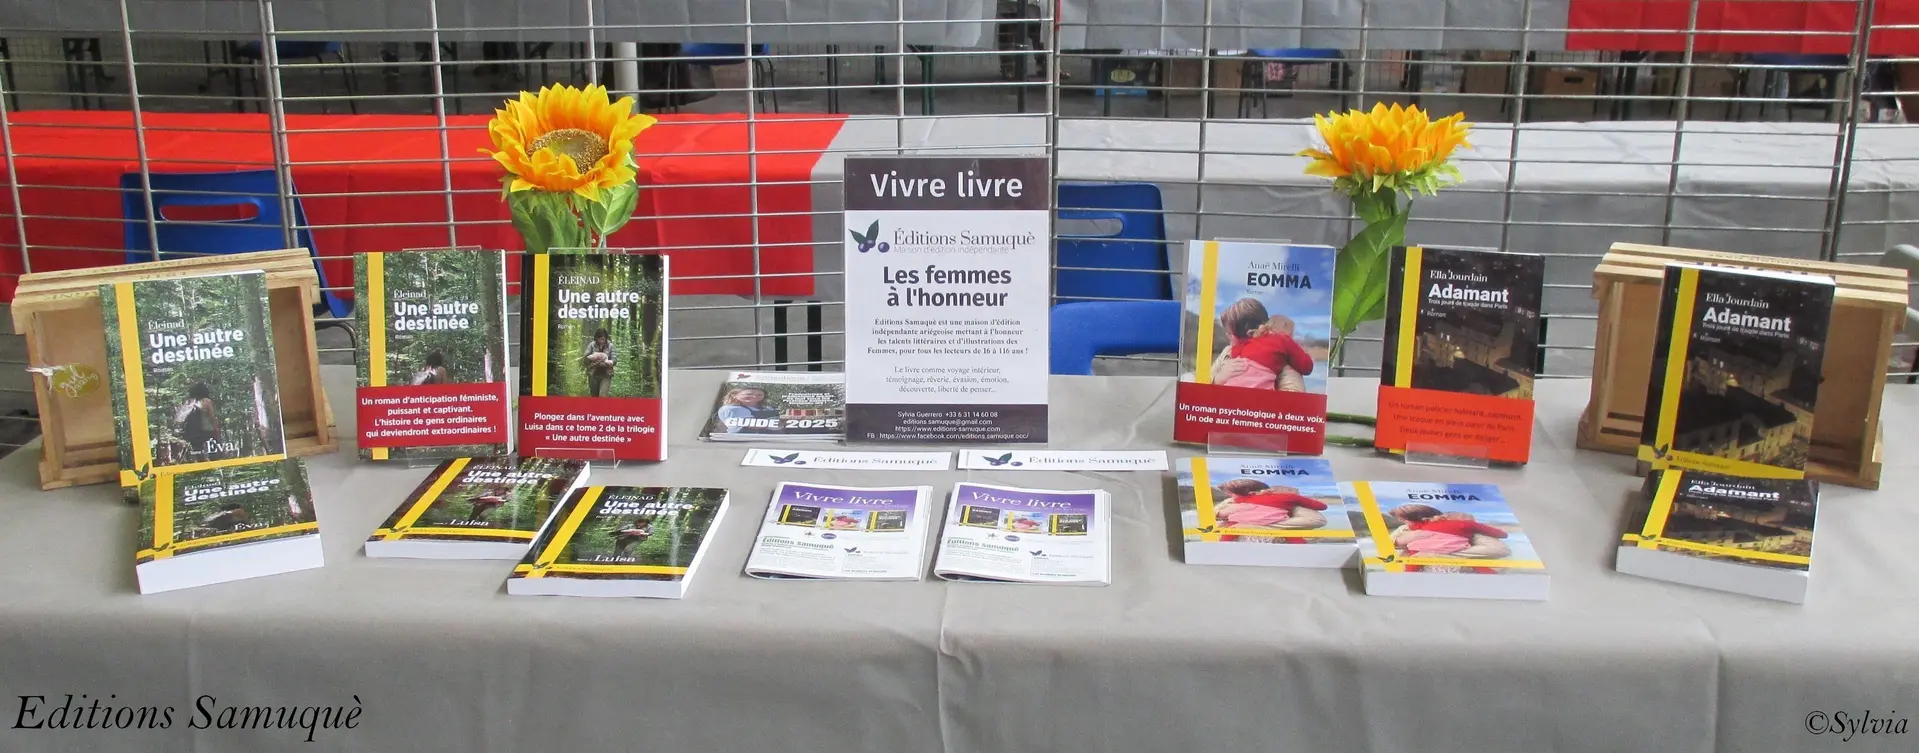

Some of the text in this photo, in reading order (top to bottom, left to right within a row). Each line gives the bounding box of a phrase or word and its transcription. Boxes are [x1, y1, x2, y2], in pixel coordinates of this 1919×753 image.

[870, 170, 1023, 197] Vivre livre
[893, 228, 1035, 249] Éditions Samuquè
[558, 275, 600, 285] ÉLEINAD
[884, 265, 1011, 284] Les femmes
[1247, 272, 1311, 289] EOMMA
[1430, 270, 1488, 282] Ella Jourdain
[394, 289, 426, 298] Éleinad
[558, 289, 639, 303] Une autre
[887, 287, 1008, 307] à l'honneur
[1428, 283, 1509, 303] Adamant
[1706, 292, 1770, 309] Ella Jourdain
[394, 301, 479, 315] Une autre
[558, 304, 629, 319] destinée
[148, 319, 185, 331] Éleinad
[395, 315, 468, 331] destinée
[905, 319, 936, 327] Samuquè
[1703, 307, 1792, 332] Adamant
[150, 329, 244, 348] Une autre
[872, 328, 918, 336] indépendante
[920, 328, 953, 336] ariégeoise
[152, 344, 234, 364] destinée
[886, 376, 925, 384] témoignage,
[927, 376, 950, 384] rêverie,
[403, 395, 457, 404] d'anticipation
[460, 394, 498, 402] féministe,
[388, 408, 420, 416] puissant
[434, 406, 473, 415] captivant.
[535, 413, 564, 422] Plongez
[567, 413, 584, 421] dans
[587, 413, 625, 422] l'aventure
[1179, 403, 1190, 411] Un
[1219, 408, 1276, 420] psychologique
[1278, 412, 1282, 420] à
[1285, 412, 1304, 422] deux
[1307, 415, 1325, 424] voix.
[375, 418, 411, 426] L'histoire
[426, 418, 444, 426] gens
[546, 423, 563, 431] dans
[627, 425, 655, 434] trilogie
[725, 418, 838, 428] GUIDE 2025
[1186, 414, 1196, 422] Un
[1199, 416, 1213, 424] ode
[1232, 418, 1263, 428] femmes
[1265, 423, 1316, 434] courageuses.
[366, 429, 378, 438] qui
[381, 428, 429, 436] deviendront
[432, 426, 491, 435] extraordinaires
[592, 435, 625, 443] destinée
[206, 438, 235, 454] Éva
[467, 470, 553, 479] Une autre
[184, 478, 280, 496] Une autre
[1688, 484, 1780, 499] Adamant
[184, 486, 269, 503] destinée
[794, 490, 893, 505] Vivre livre
[971, 491, 1071, 509] Vivre livre
[1408, 493, 1481, 501] EOMMA
[600, 507, 678, 516] destinée
[604, 500, 693, 509] Une autre
[594, 555, 636, 563] Luisa
